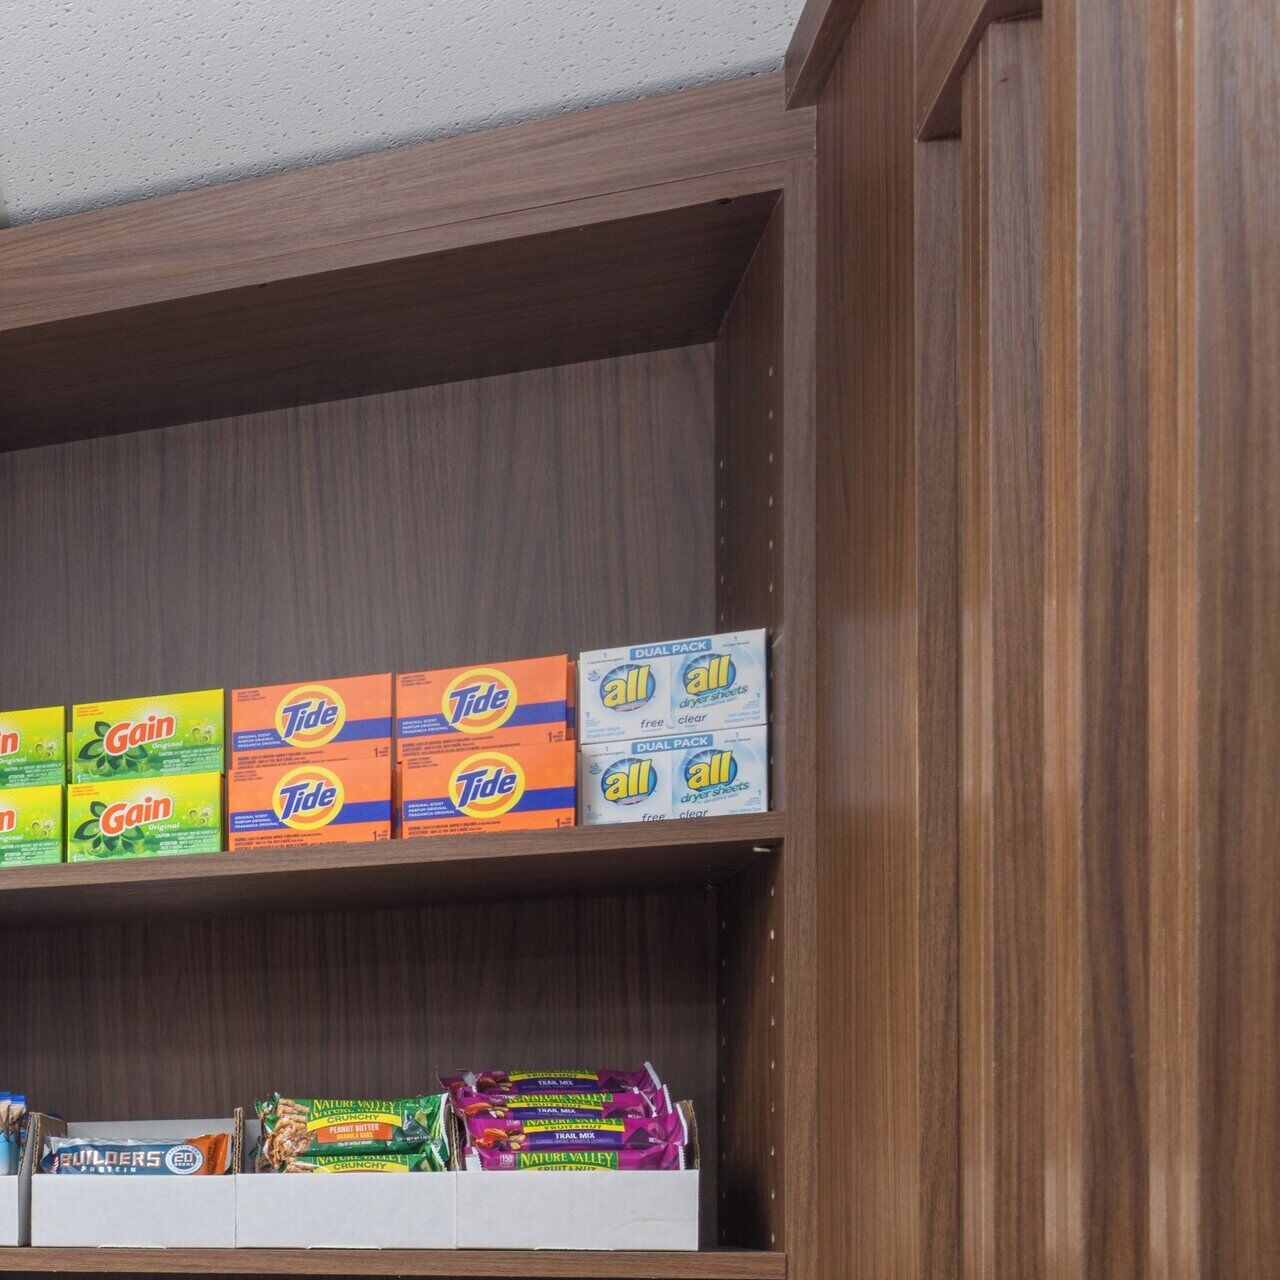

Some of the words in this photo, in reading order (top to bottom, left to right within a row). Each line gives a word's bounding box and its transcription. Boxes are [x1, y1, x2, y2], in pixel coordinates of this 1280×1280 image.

[635, 645, 669, 659] DUAL
[672, 641, 708, 655] PACK
[686, 654, 737, 696] all
[605, 664, 656, 711] all
[448, 686, 509, 721] Tide
[282, 702, 340, 737] Tide
[640, 717, 665, 729] free
[678, 713, 708, 725] clear
[104, 715, 175, 755] Gain
[637, 741, 671, 752] DUAL
[674, 735, 710, 749] PACK
[687, 750, 739, 791] all
[455, 770, 515, 807] Tide
[605, 759, 657, 804] all
[279, 784, 338, 818] Tide
[100, 796, 172, 835] Gain
[148, 822, 181, 831] Original
[328, 1113, 381, 1122] CRUNCHY
[329, 1125, 354, 1133] PEANUT
[356, 1124, 379, 1132] BUTTER
[555, 1132, 577, 1140] TRAIL
[60, 1151, 161, 1168] BUILDERS
[173, 1152, 194, 1163] 20
[520, 1152, 561, 1168] NATURE
[565, 1153, 614, 1167] VALLEY
